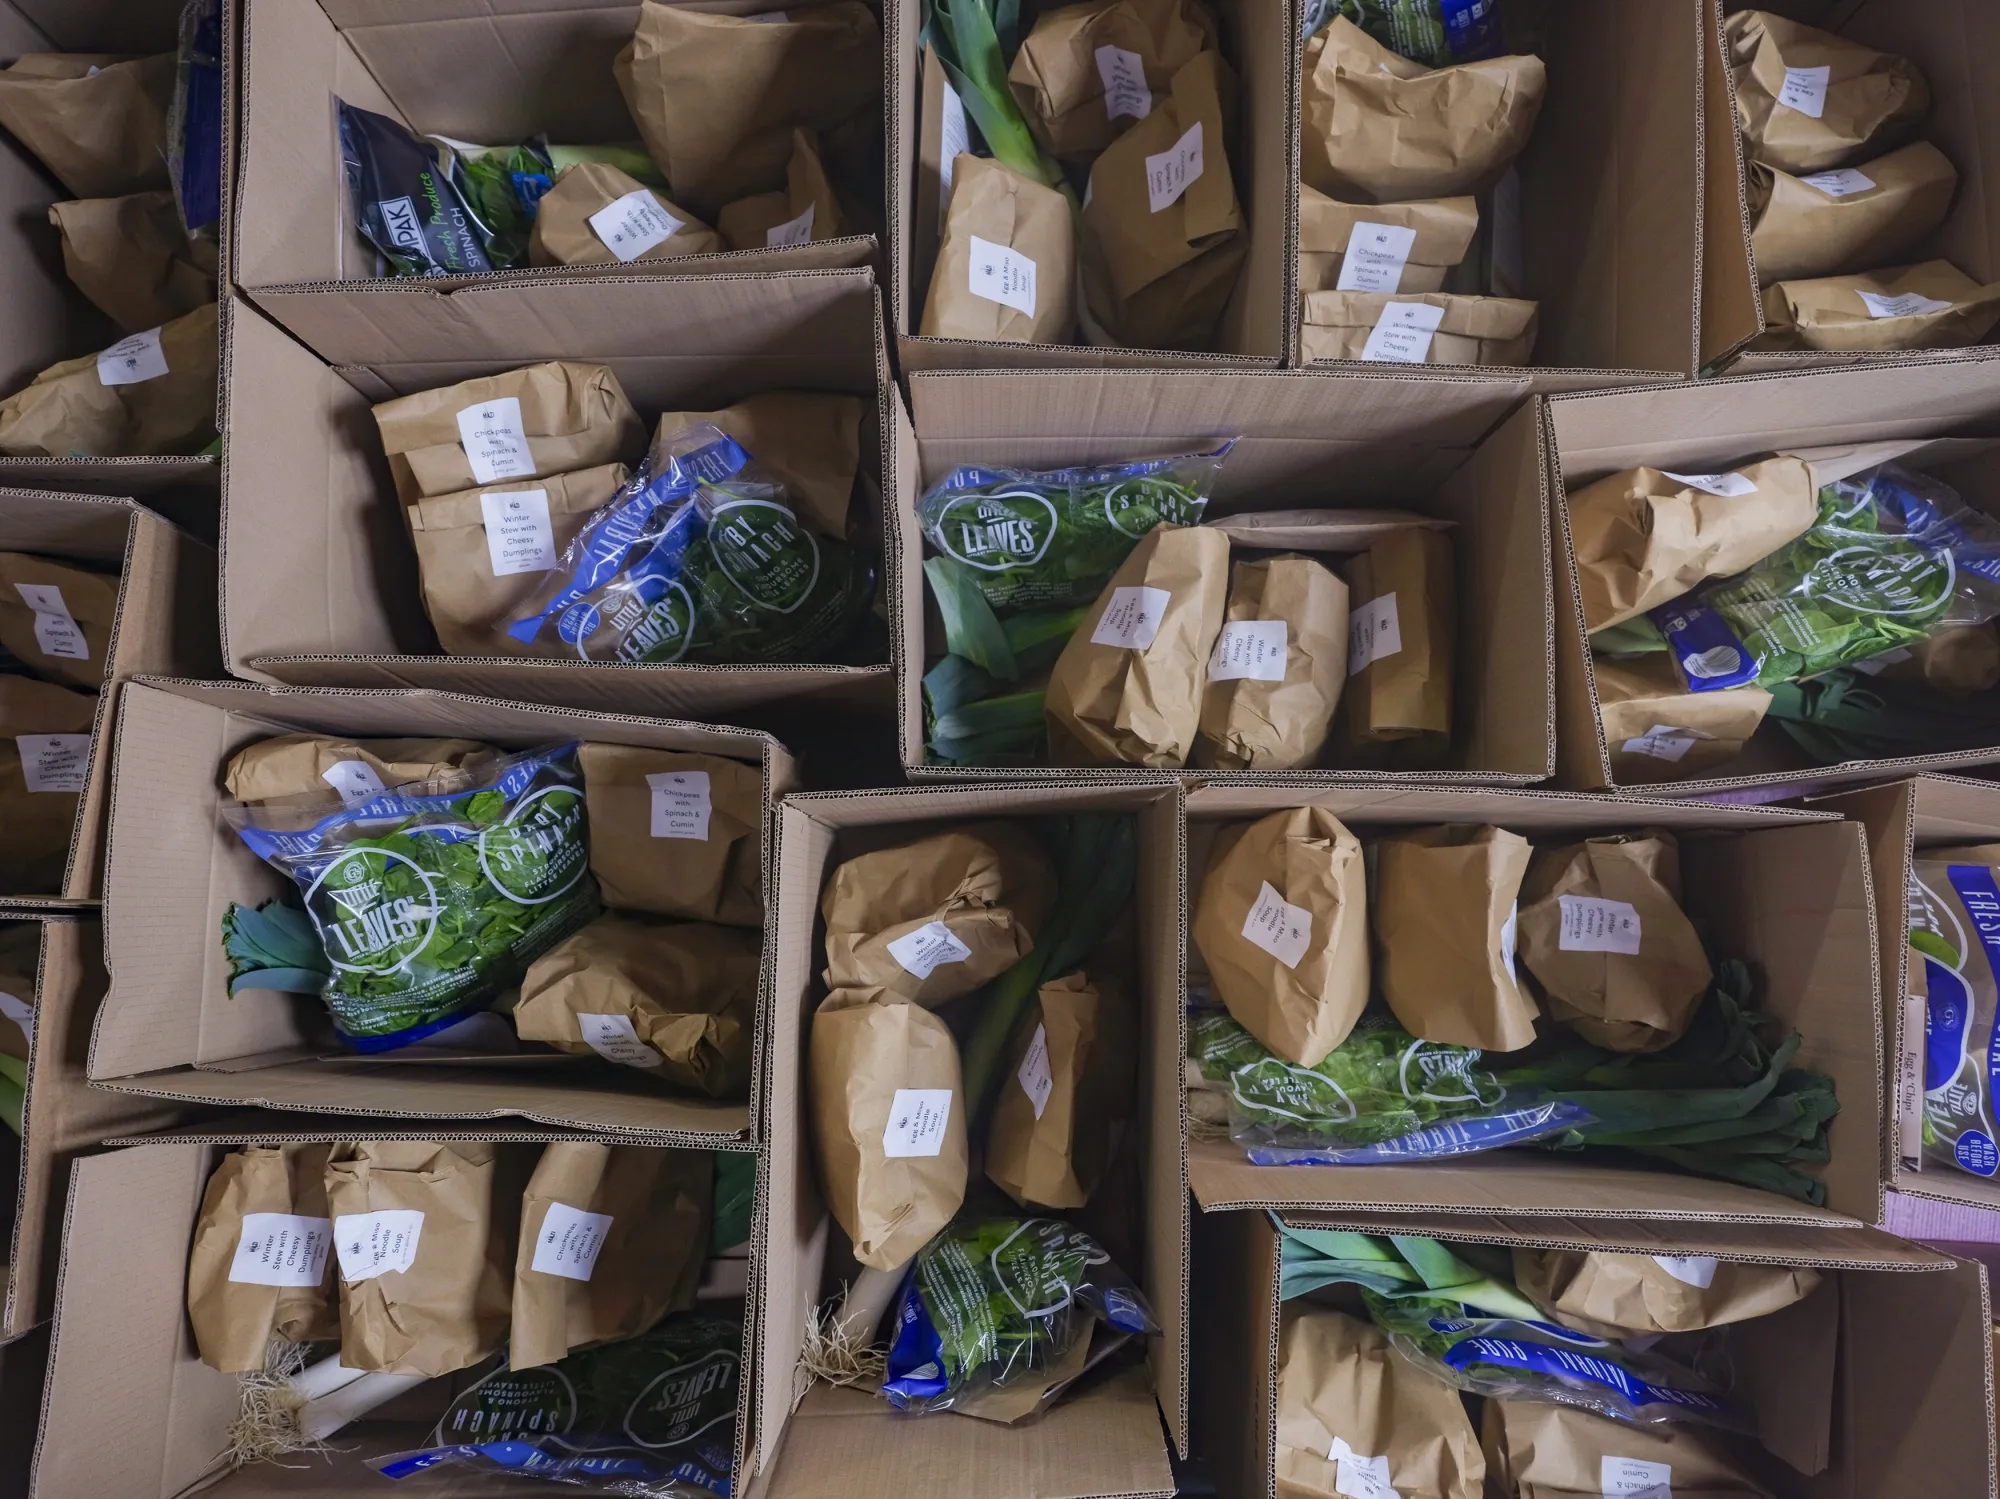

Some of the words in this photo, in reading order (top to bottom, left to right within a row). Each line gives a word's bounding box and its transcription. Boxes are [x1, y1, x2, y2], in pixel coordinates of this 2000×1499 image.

[420, 172, 449, 225] Produce
[450, 207, 480, 267] SPINACH
[436, 231, 464, 269] Fresh
[1358, 248, 1395, 260] Chickpeas
[1353, 266, 1382, 276] Spinach
[1356, 275, 1380, 285] Cumin
[1392, 322, 1416, 330] Winter
[1383, 331, 1400, 339] Stew
[1401, 334, 1417, 343] with
[1383, 341, 1409, 353] Cheesy
[474, 427, 512, 439] Chickpeas
[481, 447, 510, 458] Spinach
[490, 457, 515, 468] Cumin
[503, 514, 530, 523] Winter
[500, 526, 519, 535] Stew
[520, 524, 537, 533] with
[961, 519, 1035, 554] LEAVES
[506, 536, 534, 546] Cheesy
[502, 547, 542, 558] Dumplings
[1109, 608, 1122, 625] Soup
[1232, 638, 1243, 662] Cheesy
[1247, 634, 1255, 651] Stew
[1256, 639, 1265, 664] Winter
[663, 788, 701, 799] Chickpeas
[664, 809, 694, 818] Spinach
[670, 820, 695, 829] Cumin
[524, 839, 583, 888] FLAVOURSOME
[528, 873, 558, 895] LITTLE
[558, 847, 585, 874] LEAVES
[532, 848, 564, 876] STRONG
[1259, 905, 1273, 923] Soup
[1267, 908, 1280, 931] Noodle
[1585, 908, 1595, 934] Cheesy
[331, 897, 418, 958] LEAVES
[1272, 926, 1285, 943] Miso
[1904, 1051, 1918, 1073] Egg
[1907, 1072, 1917, 1081] &
[910, 1129, 919, 1144] Egg
[915, 1100, 924, 1120] Miso
[919, 1108, 931, 1136] Noodle
[928, 1112, 939, 1133] Soup
[1957, 1143, 1970, 1160] USE
[1969, 1138, 1983, 1169] BEFORE
[1982, 1142, 1996, 1167] WASH
[371, 1222, 381, 1242] Miso
[556, 1222, 578, 1261] Chickpeas
[569, 1234, 580, 1251] with
[260, 1234, 275, 1263] Winter
[272, 1249, 284, 1271] Stew
[279, 1230, 289, 1248] with
[286, 1235, 302, 1267] Cheesy
[297, 1231, 316, 1273] Dumplings
[379, 1229, 392, 1258] Noodle
[391, 1232, 404, 1254] Soup
[573, 1233, 589, 1264] Spinach
[585, 1225, 593, 1233] &
[583, 1233, 599, 1260] Cumin
[1466, 1338, 1529, 1362] PURE
[1548, 1347, 1631, 1397] NATURAL
[477, 1387, 554, 1397] FLAVOURSOME
[520, 1380, 556, 1390] LITTLE
[656, 1360, 734, 1412] LEAVES
[487, 1397, 496, 1406] &
[498, 1396, 539, 1407] STRONG
[451, 1409, 559, 1433] SPINACH
[667, 1402, 701, 1426] LITTLE
[1616, 1481, 1623, 1489] &
[1622, 1470, 1649, 1480] Cumin
[1624, 1481, 1656, 1492] Spinach
